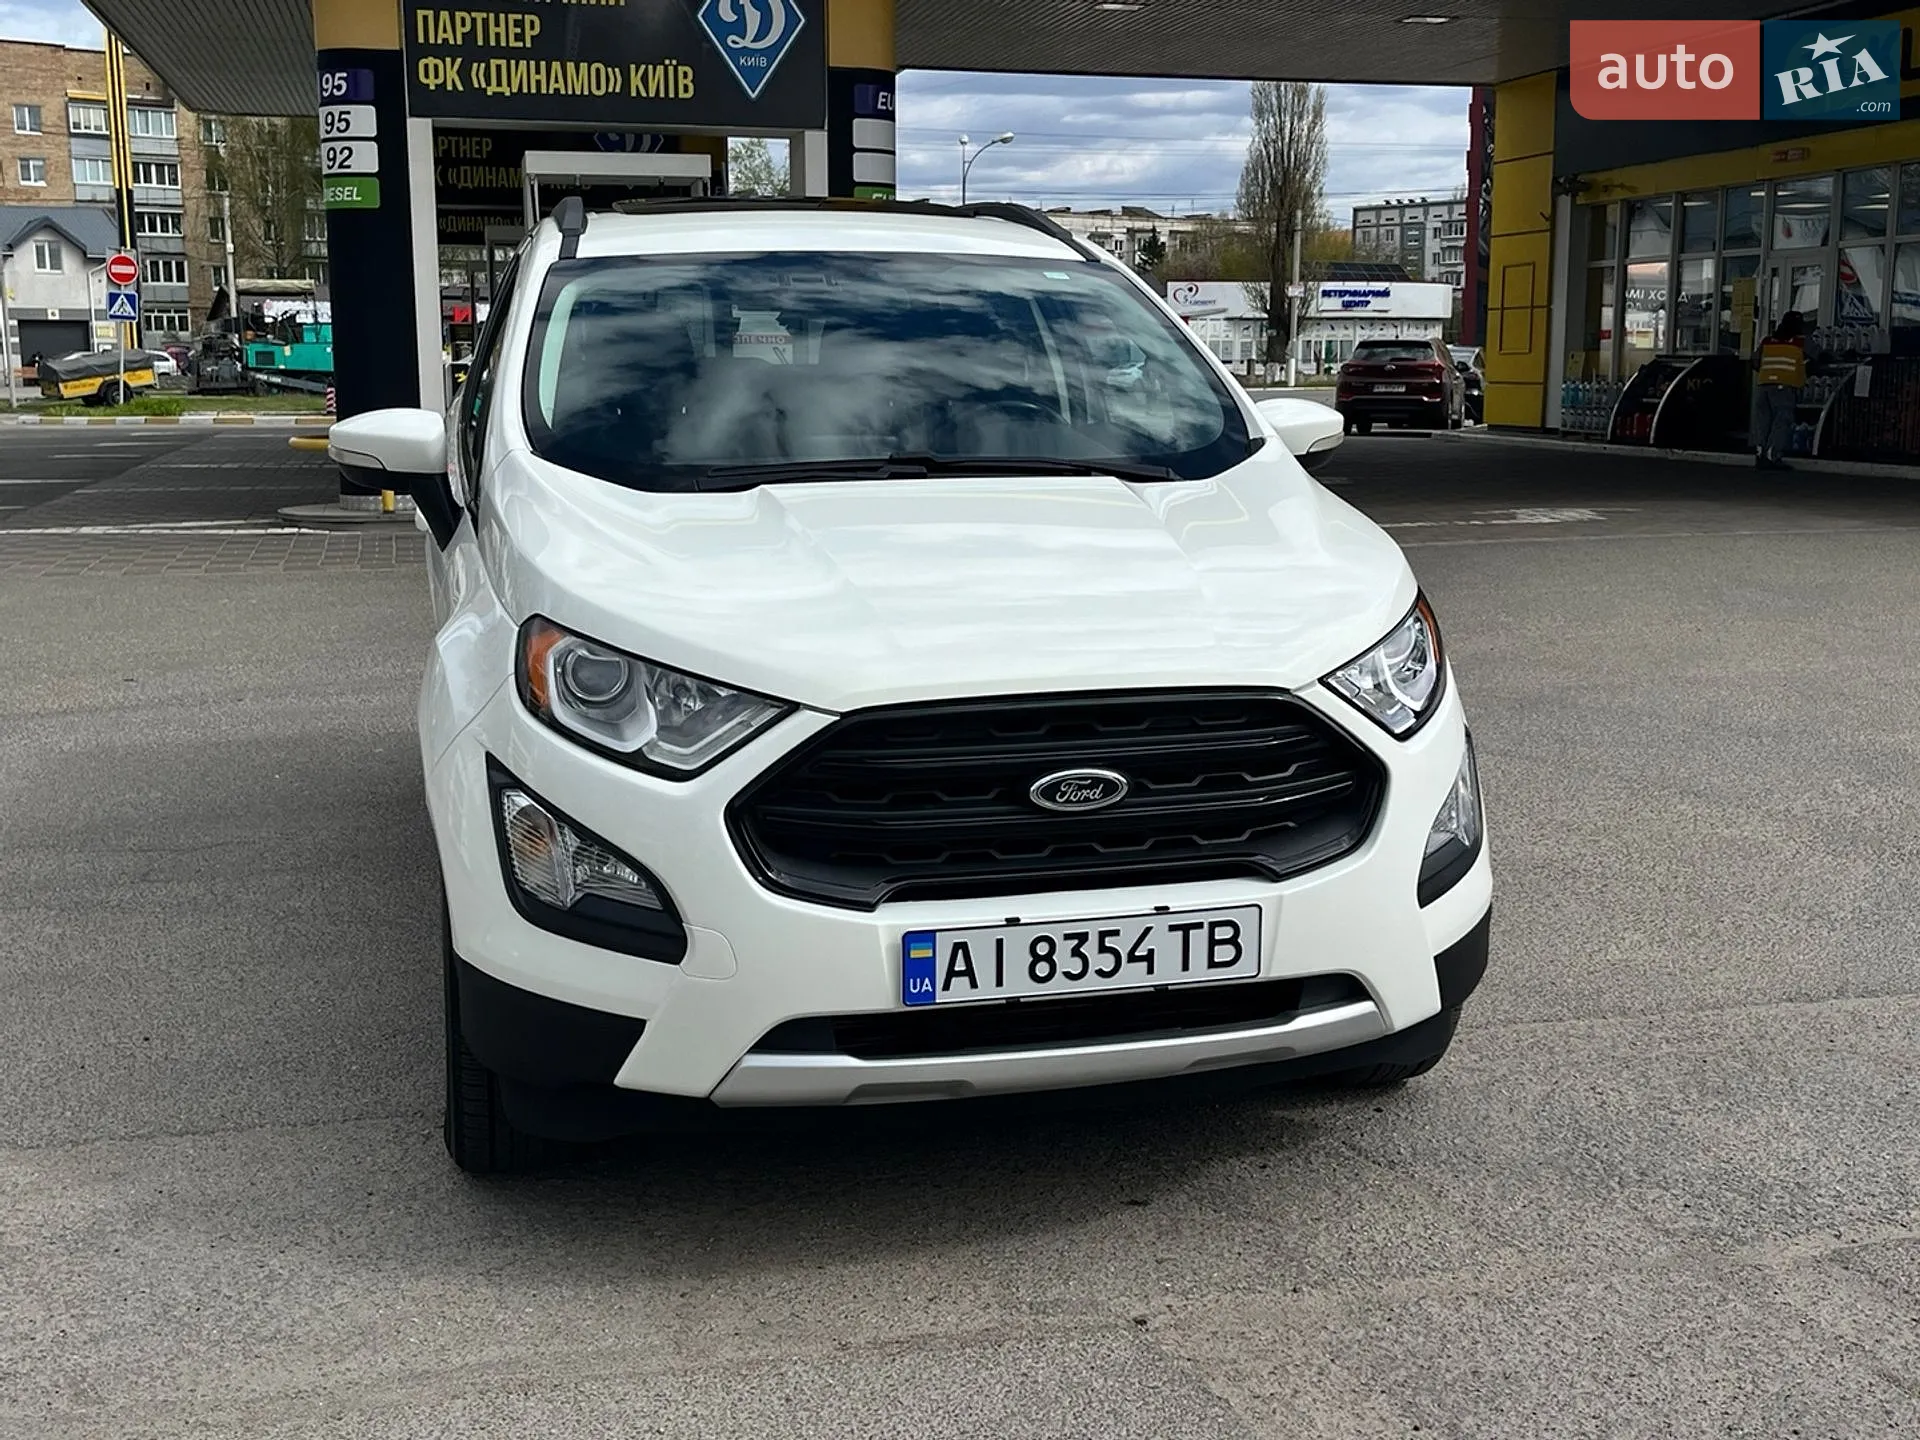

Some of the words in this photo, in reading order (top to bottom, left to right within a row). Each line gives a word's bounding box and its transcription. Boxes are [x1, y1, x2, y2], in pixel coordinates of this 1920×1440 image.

[416, 9, 541, 48] ПАРТНЕР
[322, 72, 348, 97] 95
[418, 56, 464, 91] ФК
[470, 58, 622, 97] «ДИНАМО»
[629, 59, 695, 99] КИЇВ
[324, 111, 351, 134] 95
[326, 146, 353, 170] 92
[1056, 779, 1104, 802] Ford
[1028, 926, 1155, 984] 8354
[910, 977, 933, 993] UA
